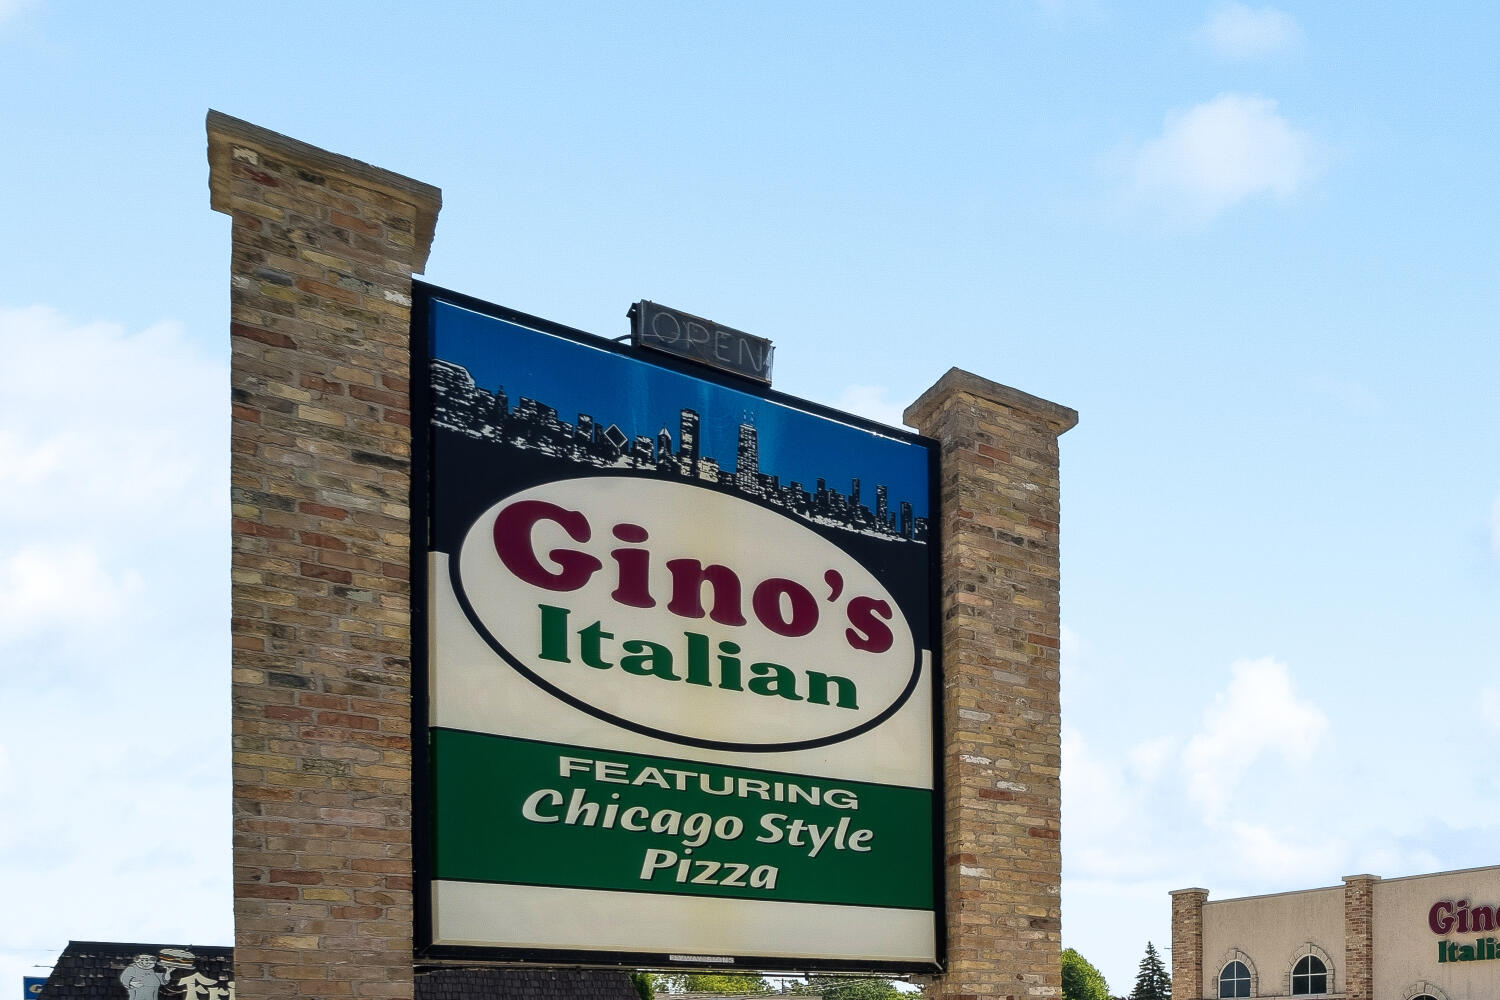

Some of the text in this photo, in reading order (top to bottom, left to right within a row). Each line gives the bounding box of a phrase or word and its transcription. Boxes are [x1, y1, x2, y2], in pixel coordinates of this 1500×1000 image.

[651, 311, 764, 372] OPEN
[492, 499, 894, 654] Gino's
[537, 603, 860, 711] Italian
[558, 755, 859, 810] FEATURING
[521, 788, 874, 858] Chicago Style
[639, 847, 779, 890] Pizza
